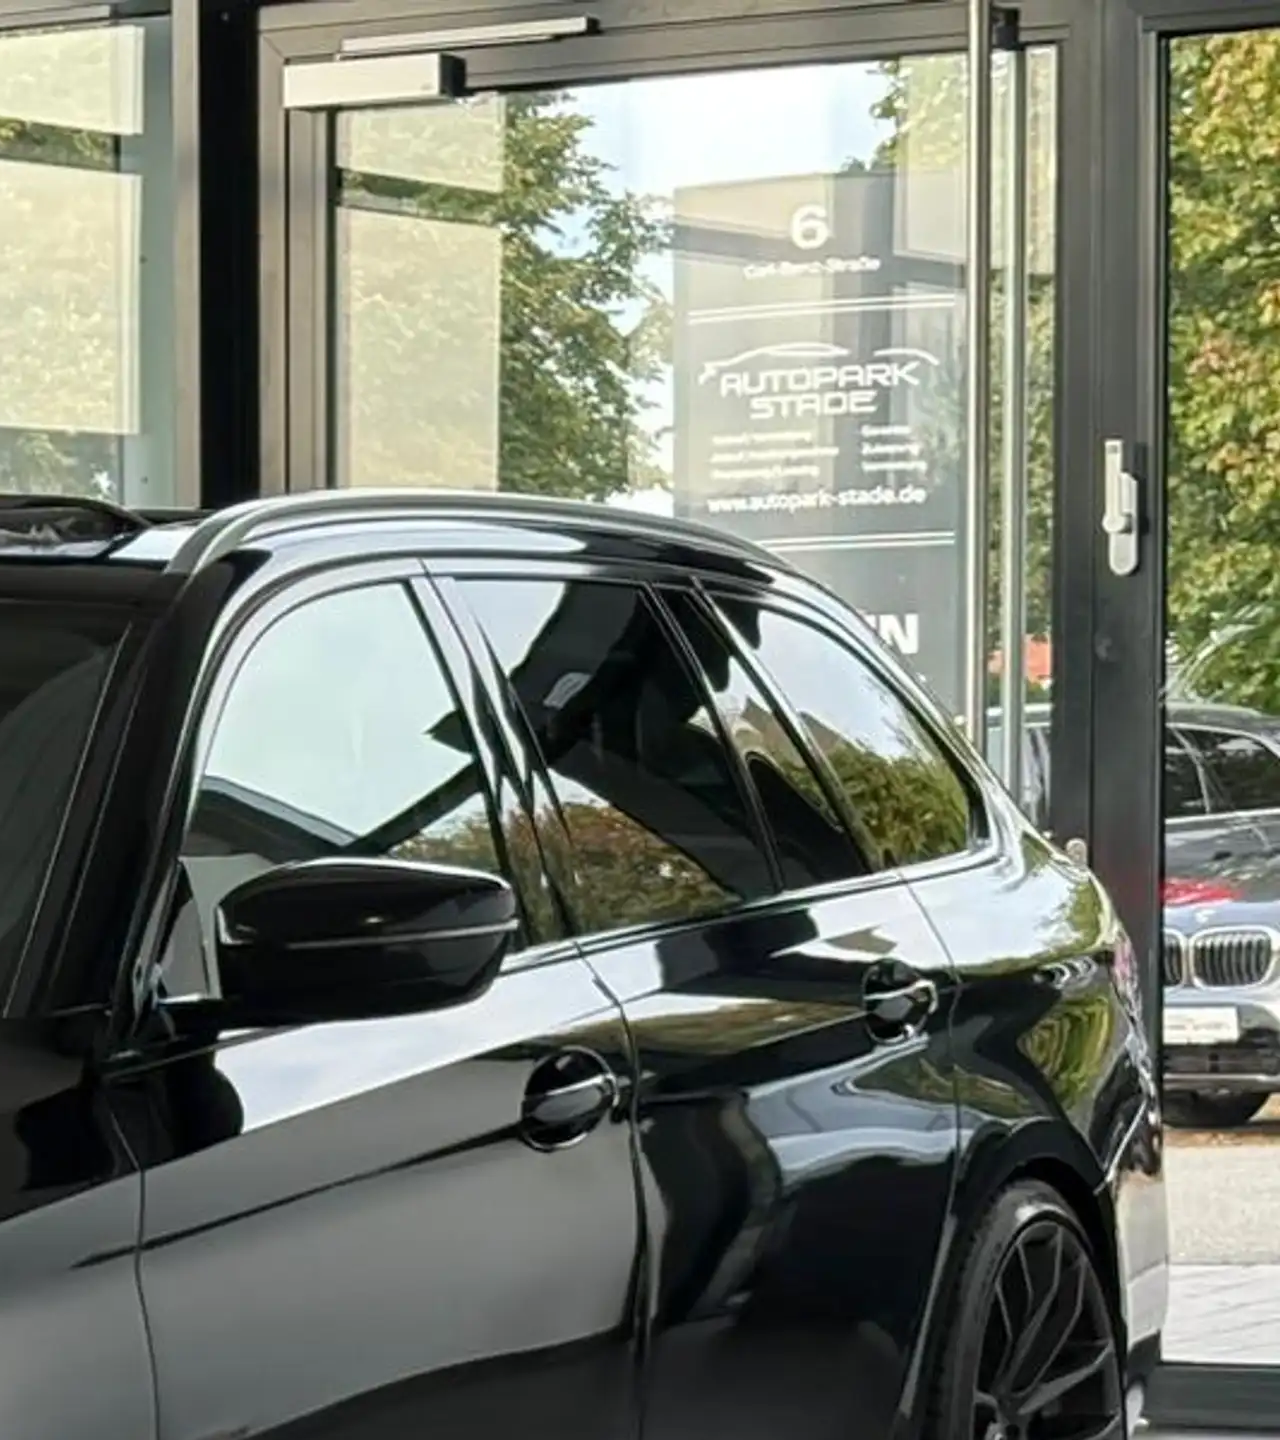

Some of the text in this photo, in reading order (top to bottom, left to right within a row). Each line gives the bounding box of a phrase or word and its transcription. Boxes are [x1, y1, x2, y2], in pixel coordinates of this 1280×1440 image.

[792, 204, 828, 250] 6
[720, 361, 920, 398] AUTOPARK
[750, 390, 878, 419] STADE
